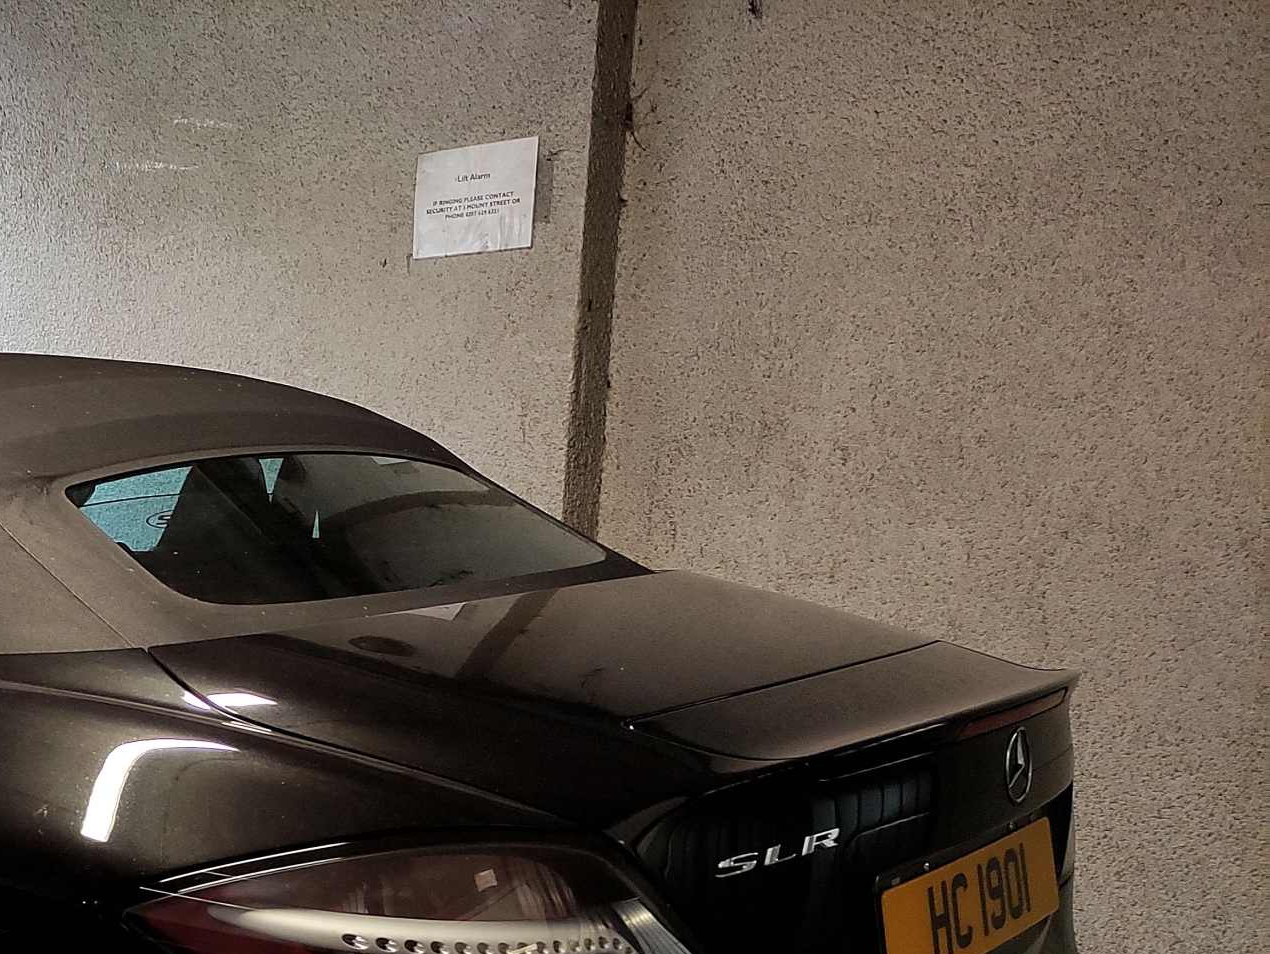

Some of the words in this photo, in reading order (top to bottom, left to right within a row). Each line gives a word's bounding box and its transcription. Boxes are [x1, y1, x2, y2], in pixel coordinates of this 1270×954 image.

[470, 173, 491, 181] Alarm
[439, 198, 462, 206] RINGING
[464, 195, 484, 203] PLEASE
[485, 191, 514, 200] CONTACT
[426, 206, 453, 214] SECURITY
[489, 199, 510, 207] STREET
[715, 827, 841, 878] SLR
[977, 841, 1032, 938] 1901
